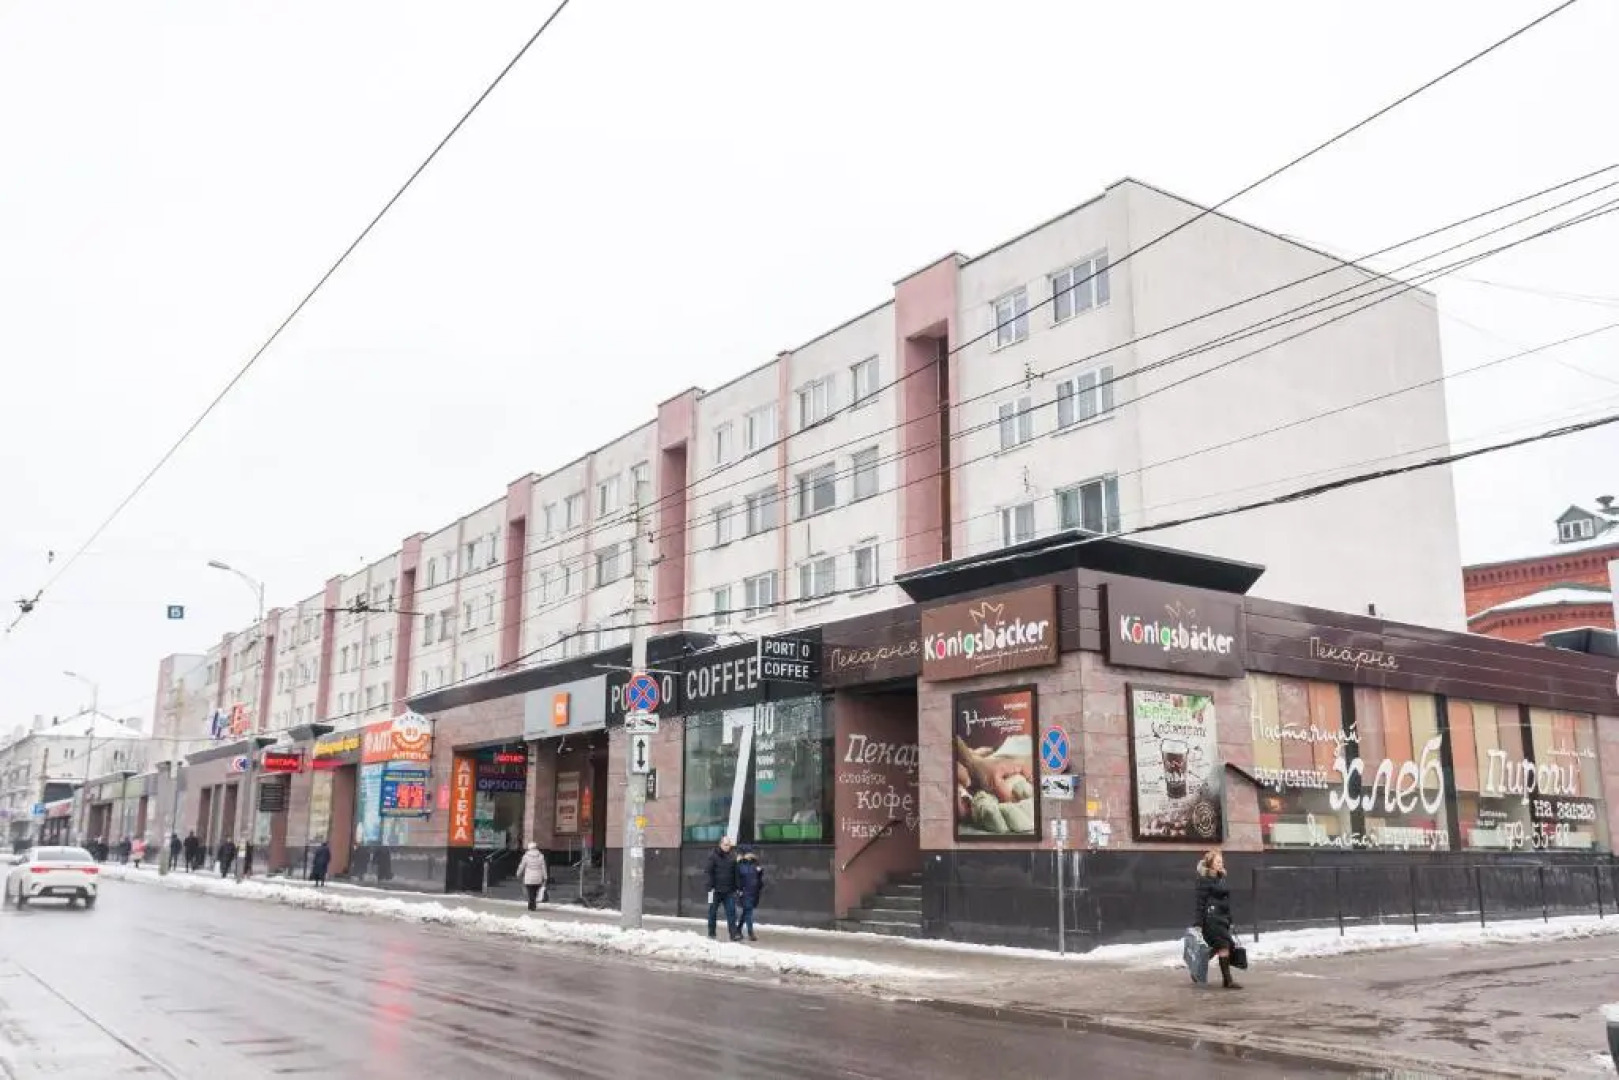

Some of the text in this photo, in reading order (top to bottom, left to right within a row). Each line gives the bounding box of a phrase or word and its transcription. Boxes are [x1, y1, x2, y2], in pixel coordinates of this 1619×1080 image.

[764, 641, 796, 656] PORT
[924, 617, 1049, 661] Königsbäcker
[1120, 614, 1234, 654] Königsbäcker
[1310, 636, 1399, 670] Пекарня
[764, 661, 809, 678] COFFEE
[831, 640, 920, 672] Пекарня
[687, 655, 758, 700] COFFEE
[1330, 734, 1444, 814] хлеб
[1486, 748, 1578, 806] Пироги
[454, 759, 471, 841] АПТЕКА
